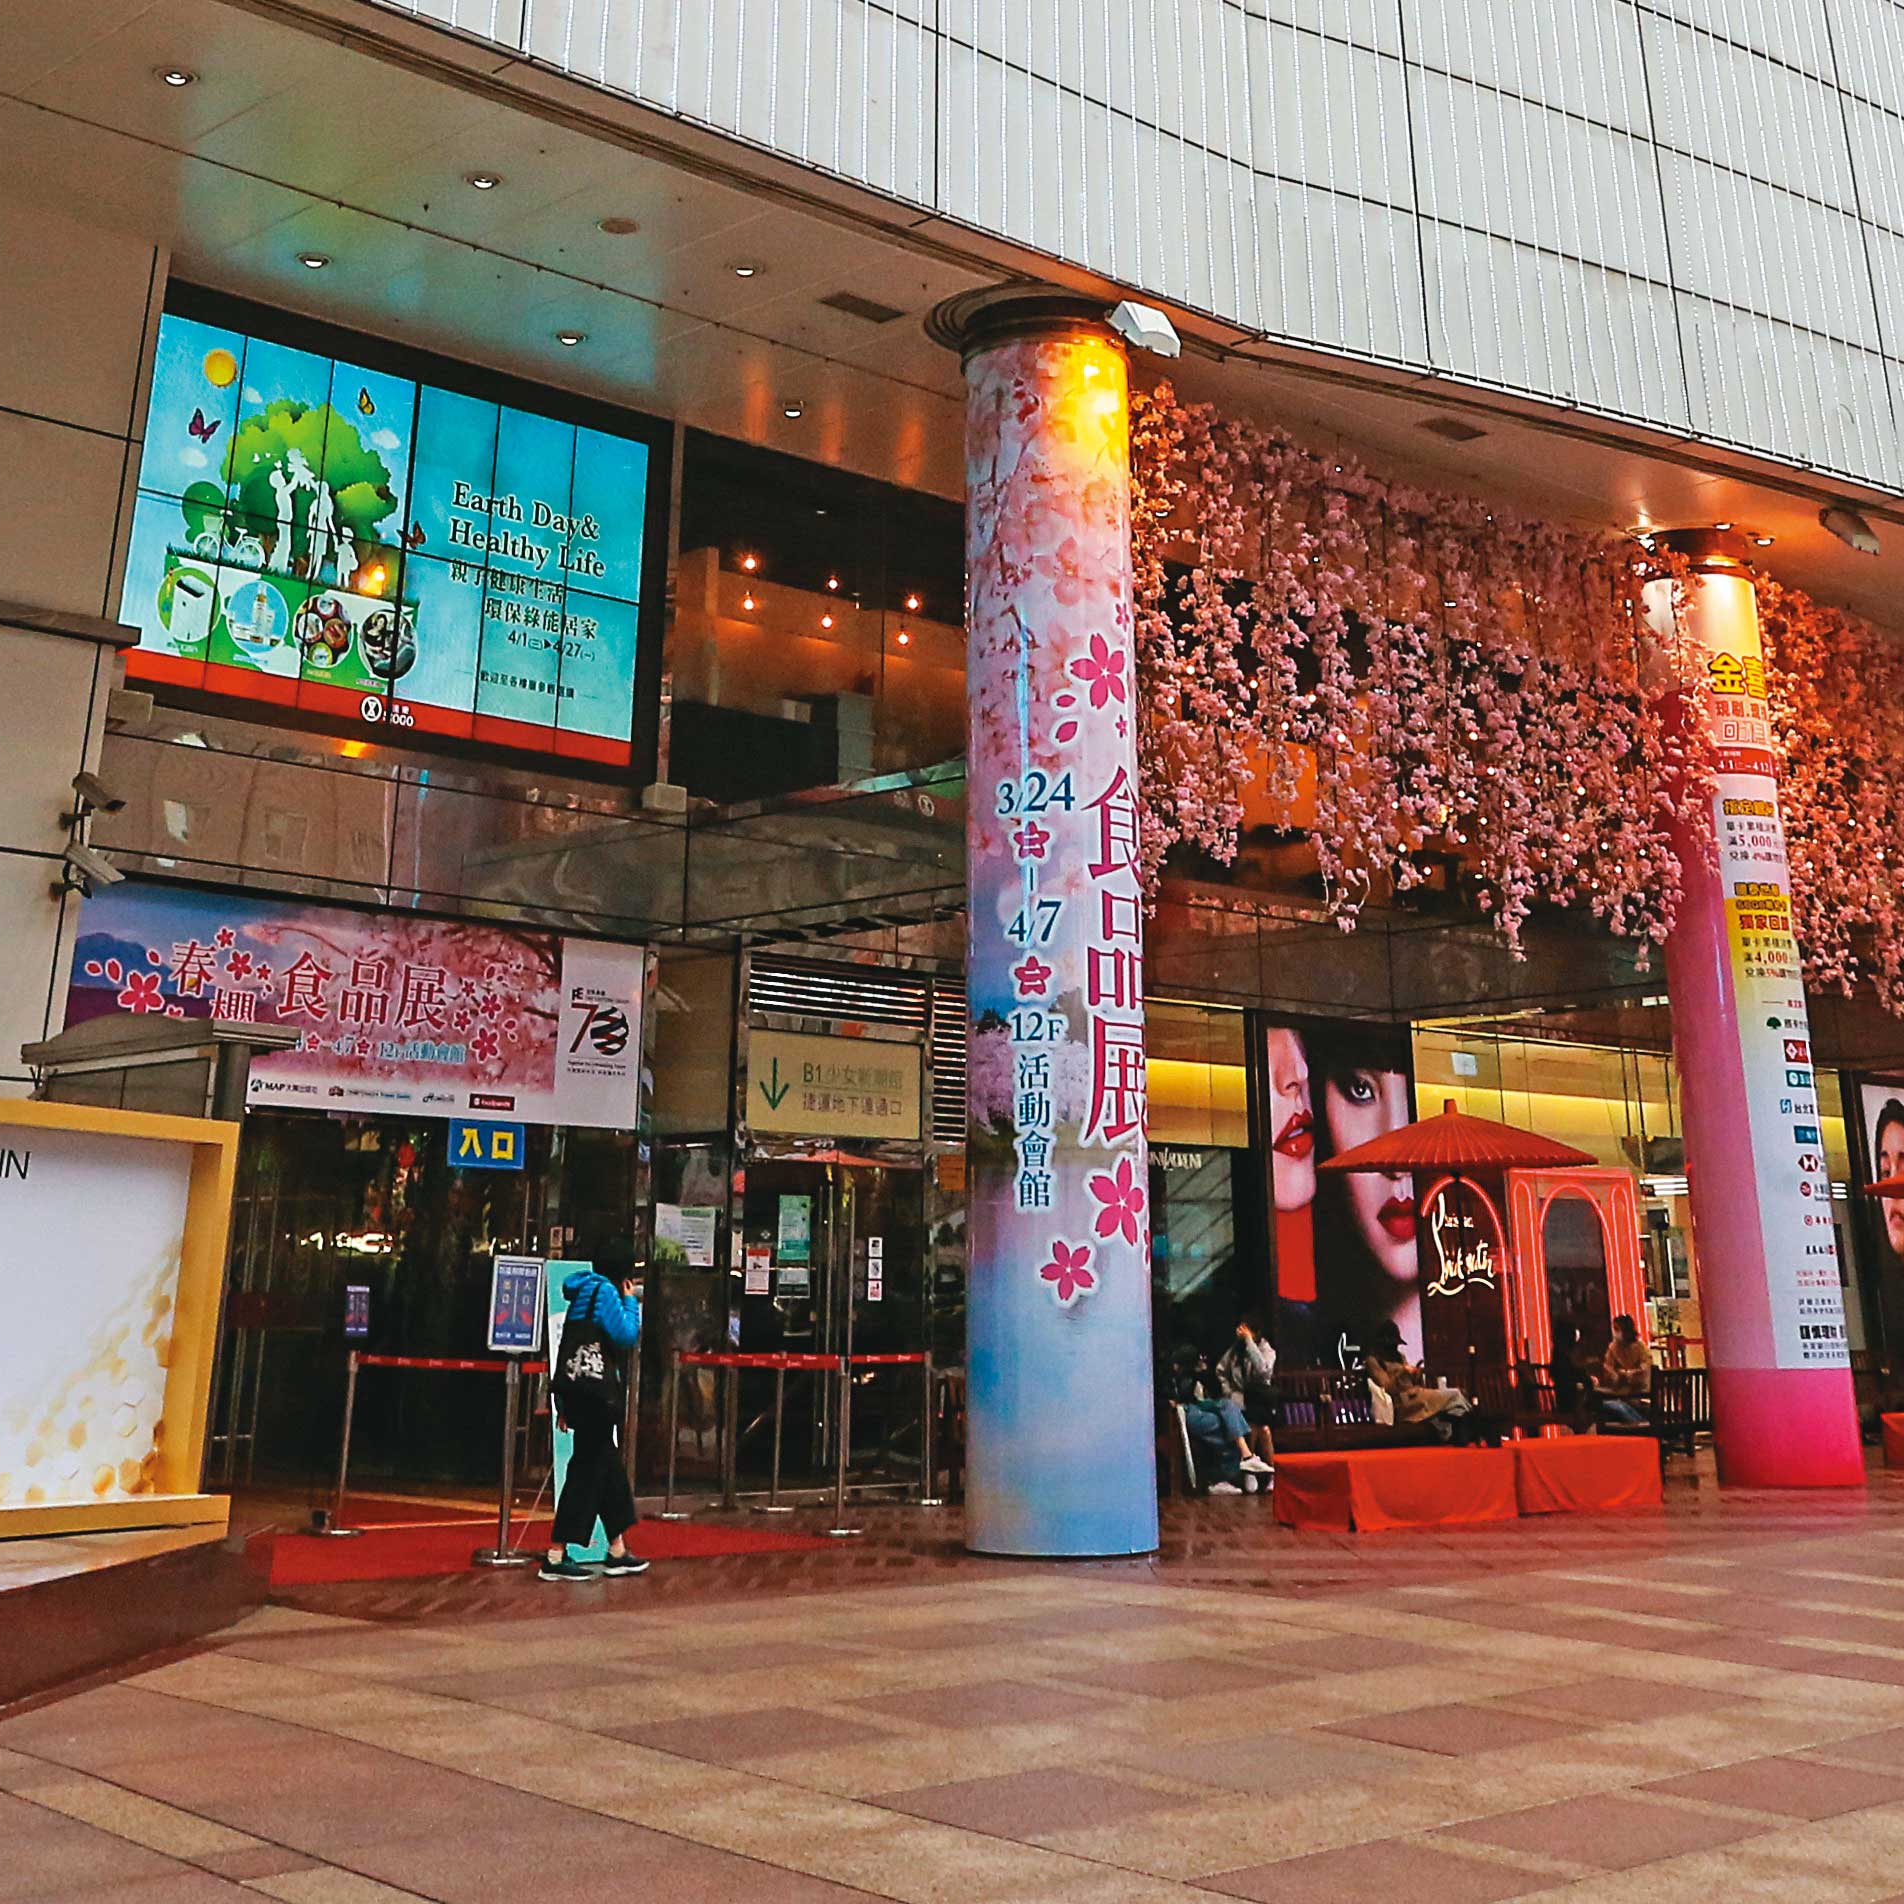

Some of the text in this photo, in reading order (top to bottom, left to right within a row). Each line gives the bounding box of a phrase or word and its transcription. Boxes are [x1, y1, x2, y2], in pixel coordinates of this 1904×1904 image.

[452, 481, 523, 521] Earth
[449, 518, 606, 577] Healthy Life
[484, 597, 597, 639] 環保綠能居家
[998, 771, 1075, 815] 3/24
[1007, 899, 1062, 944] 4/7
[274, 950, 450, 1033] 食品展
[1011, 1013, 1064, 1043] 12F
[803, 1062, 822, 1083] B1
[459, 1128, 515, 1162] 入口
[1018, 1052, 1052, 1208] 活動會館
